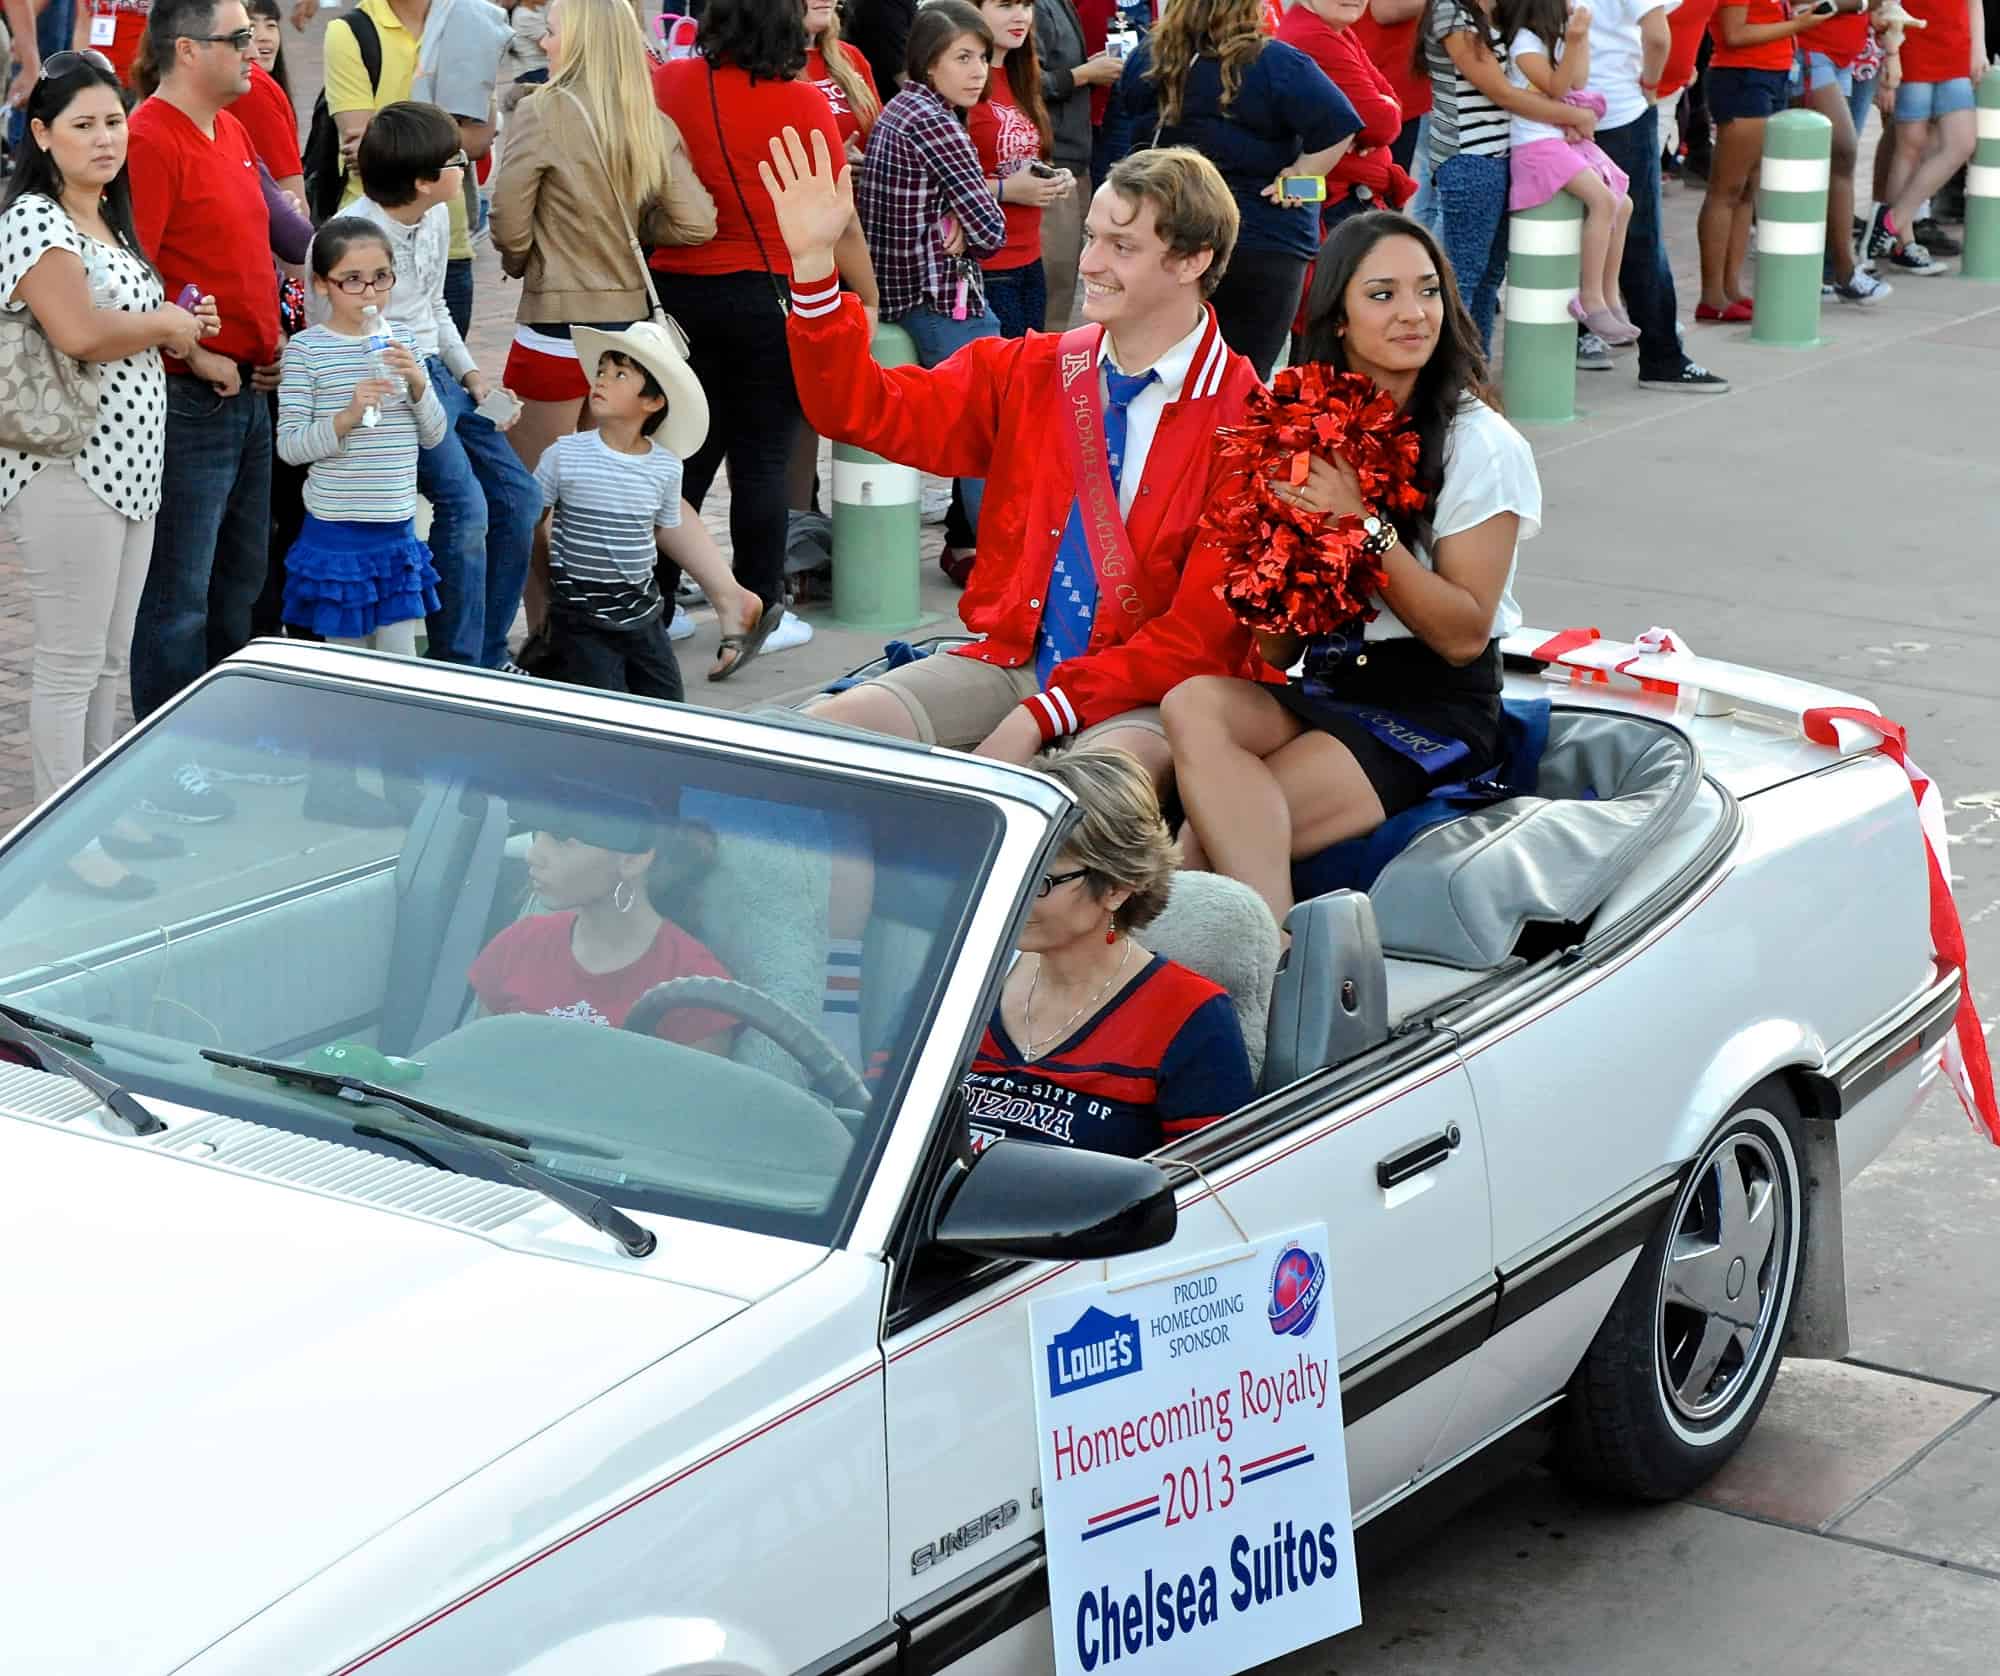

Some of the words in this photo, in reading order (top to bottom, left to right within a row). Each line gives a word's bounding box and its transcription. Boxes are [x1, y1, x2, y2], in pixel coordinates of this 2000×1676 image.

[1087, 1101, 1112, 1120] OF
[1150, 1294, 1245, 1338] HOMECOMING
[1173, 1276, 1218, 1304] PROUD
[1057, 1330, 1134, 1385] LOWE'S
[1169, 1324, 1231, 1358] SPONSOR
[1052, 1386, 1234, 1482] Homecoming
[1239, 1353, 1328, 1424] Royalty
[1162, 1454, 1235, 1528] 2013
[910, 1498, 1020, 1576] SUNBIRD
[1076, 1568, 1219, 1673] Chelsea
[1229, 1519, 1338, 1612] Suitos
